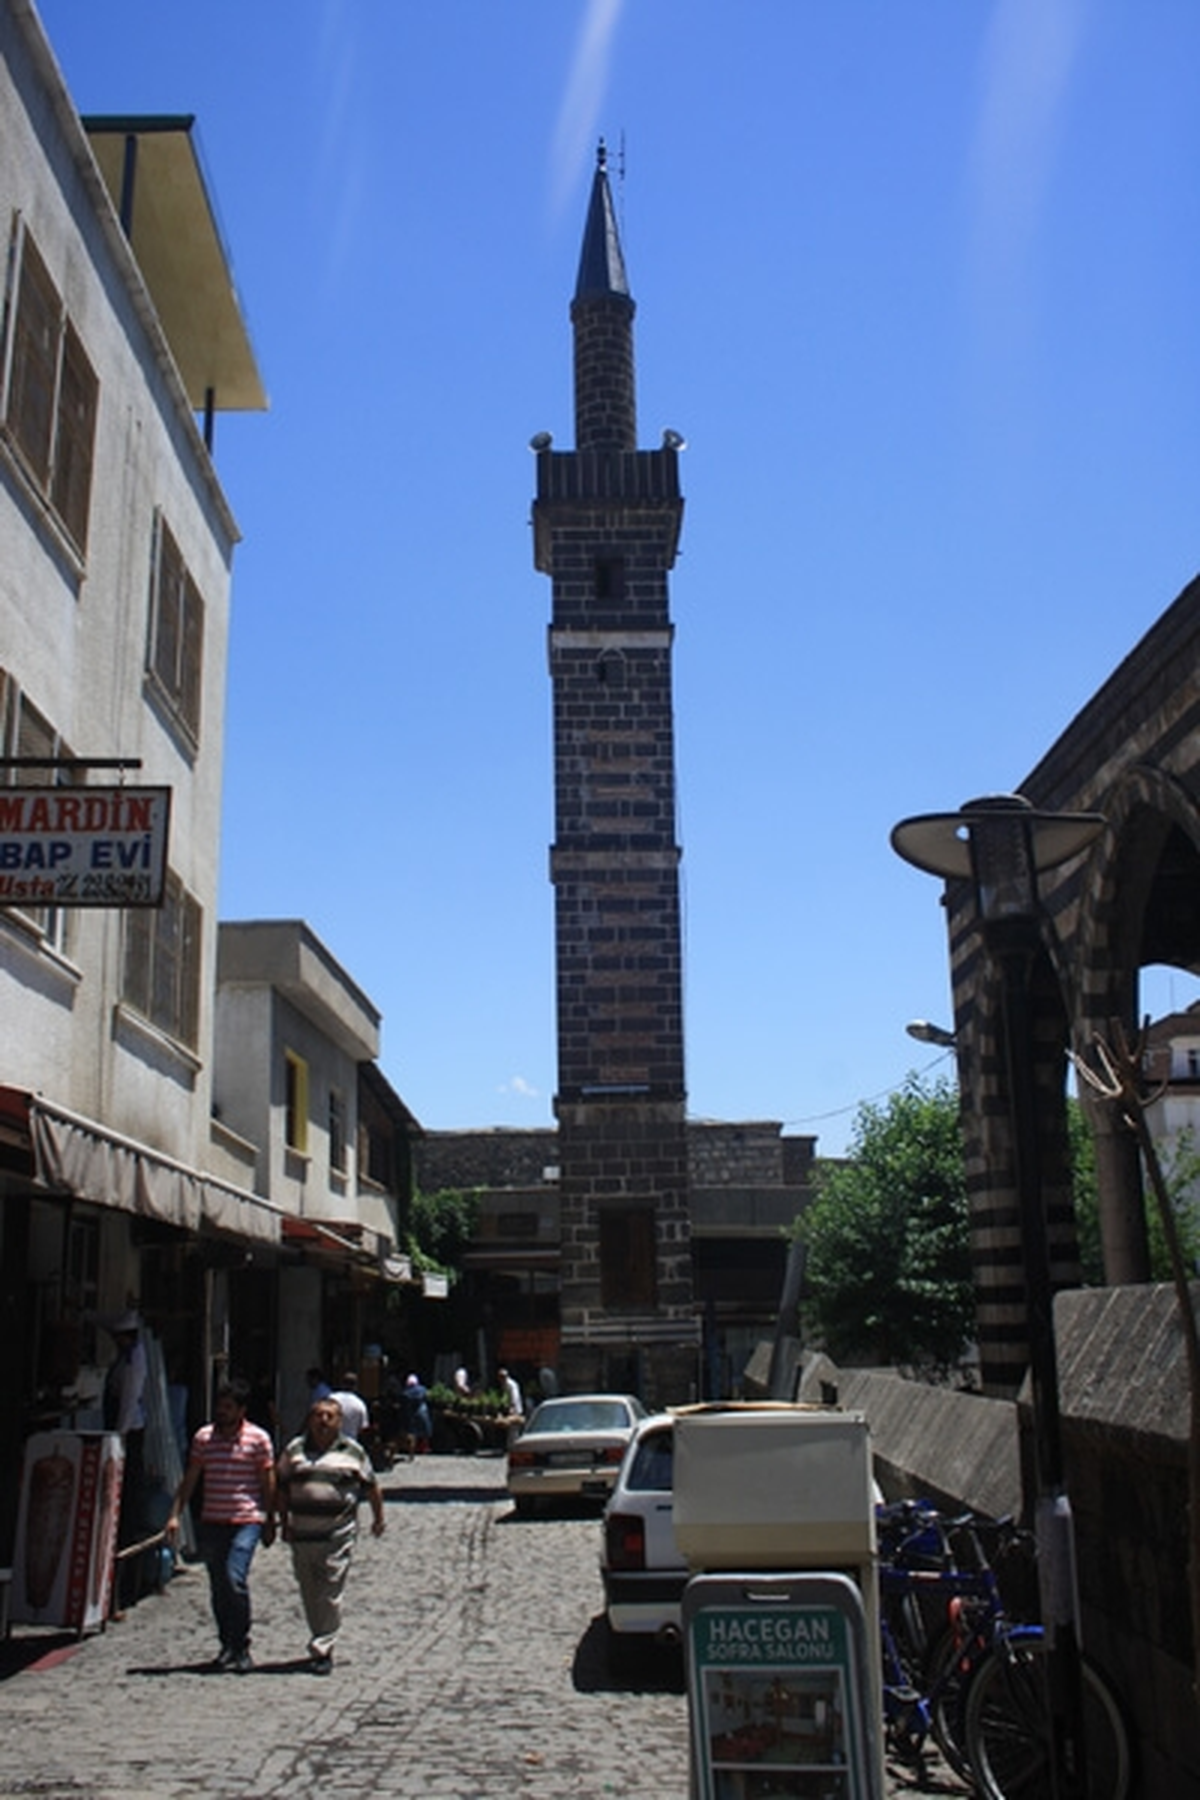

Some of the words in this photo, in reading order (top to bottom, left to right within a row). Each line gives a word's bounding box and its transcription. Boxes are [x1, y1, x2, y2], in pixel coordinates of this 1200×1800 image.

[0, 792, 153, 832] MARDİN
[0, 841, 73, 870] BAP
[90, 833, 152, 870] EVİ
[709, 1619, 830, 1642] HACEGAN
[706, 1642, 763, 1660] SOFRA
[766, 1642, 835, 1660] SALONU
